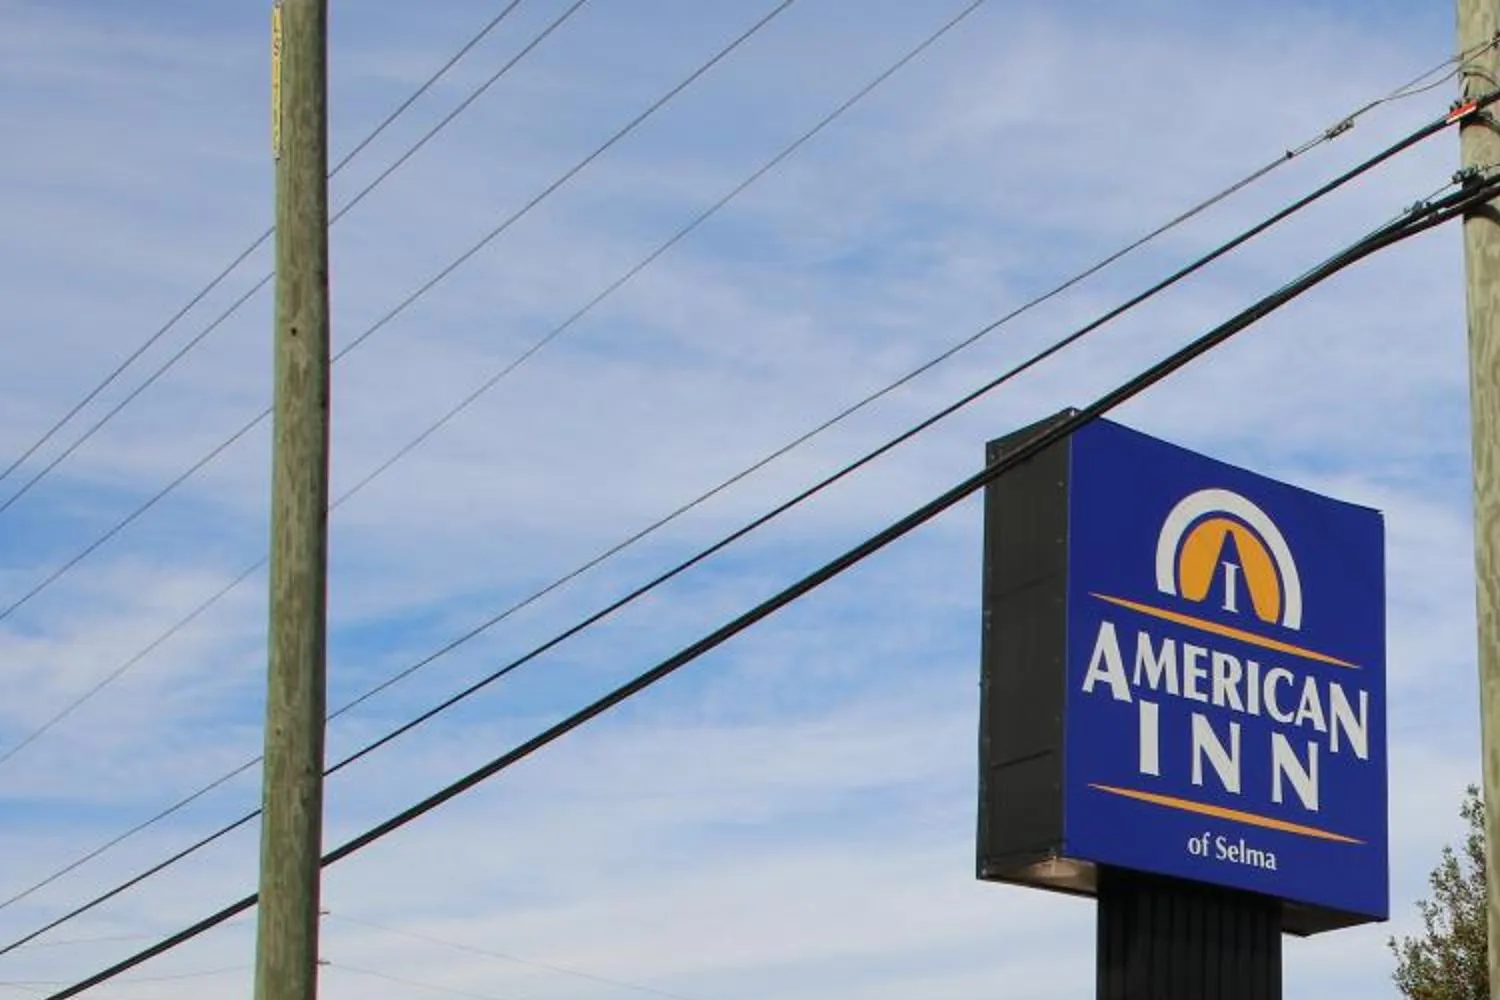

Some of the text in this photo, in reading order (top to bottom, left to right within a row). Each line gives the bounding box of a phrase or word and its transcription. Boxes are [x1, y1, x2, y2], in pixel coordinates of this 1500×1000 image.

[1082, 621, 1368, 760] AMERICAN
[1139, 700, 1319, 811] INN
[1187, 831, 1277, 871] of Selma
